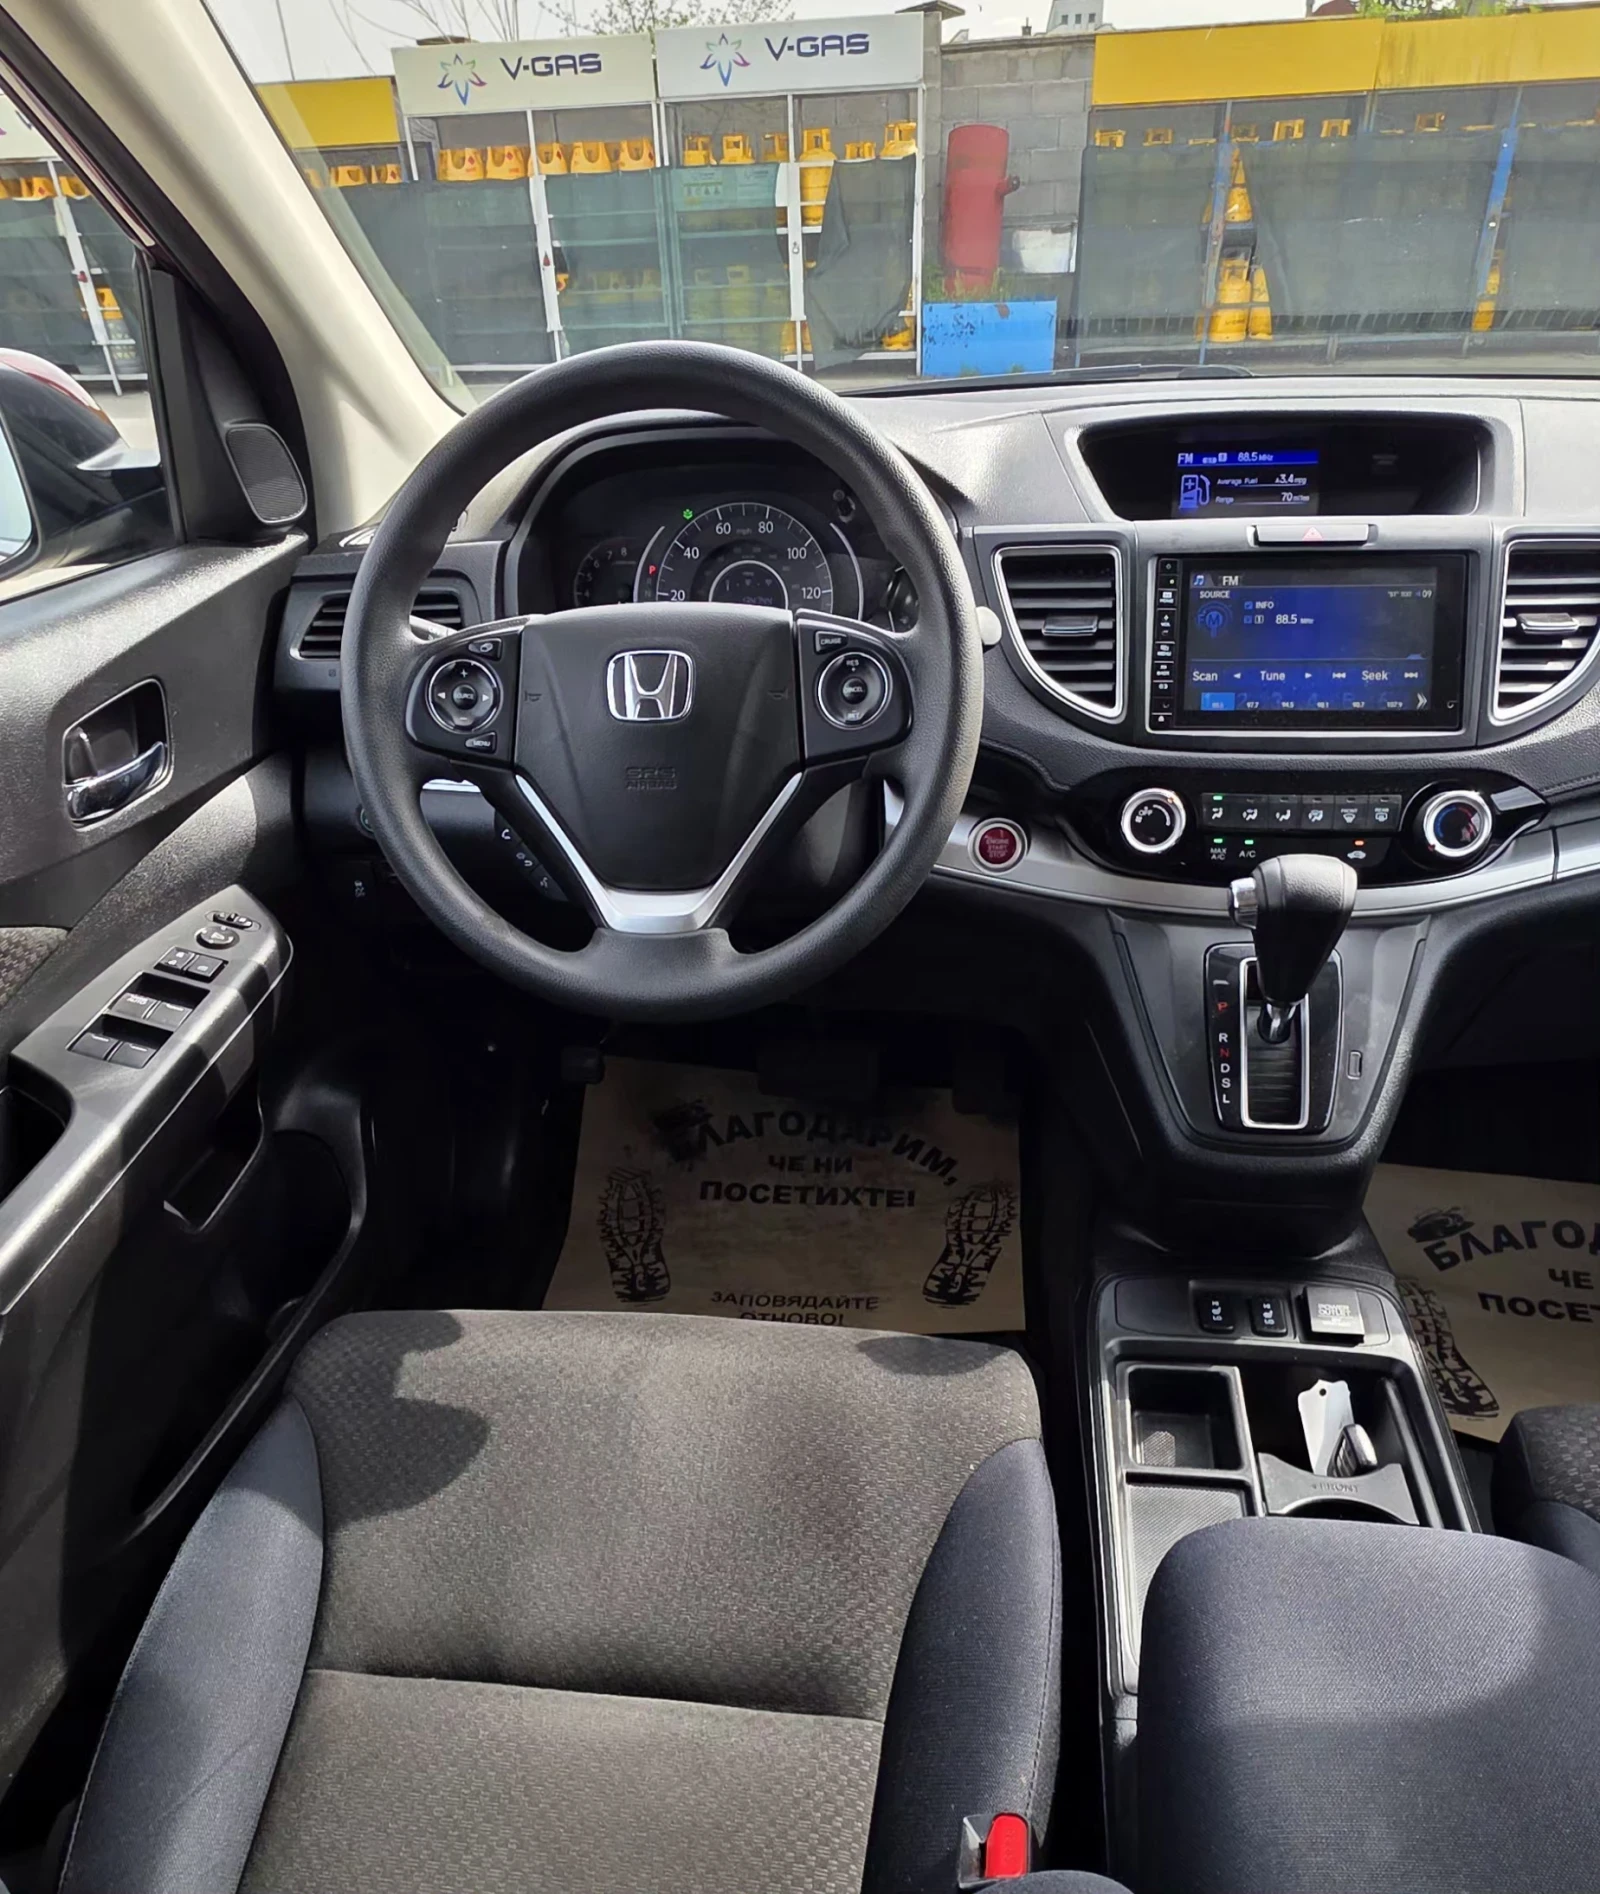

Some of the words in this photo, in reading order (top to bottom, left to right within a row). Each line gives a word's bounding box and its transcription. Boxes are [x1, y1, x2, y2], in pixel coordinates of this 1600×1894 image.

[765, 33, 870, 61] V-GAS
[500, 53, 602, 80] V-GAS
[1177, 453, 1194, 464] FM
[1237, 452, 1258, 462] 88.5
[715, 522, 732, 535] 60
[757, 520, 774, 534] 80
[683, 546, 700, 559] 40
[787, 546, 807, 559] 100
[648, 564, 657, 574] P
[1222, 575, 1239, 586] FM
[670, 589, 686, 601] 20
[801, 587, 822, 599] 120
[1199, 590, 1231, 599] SOURCE
[1255, 601, 1275, 610] INFO
[1275, 614, 1298, 625] 88.5
[820, 637, 842, 646] CRUISE
[845, 659, 860, 667] RES
[1192, 671, 1219, 681] Scan
[1260, 670, 1286, 681] Tune
[1361, 670, 1389, 681] Seek
[472, 740, 492, 748] MENU
[625, 766, 677, 779] SRS
[1210, 847, 1227, 855] MAX
[1239, 850, 1257, 859] A/C
[1211, 853, 1226, 861] A/C
[1217, 1001, 1229, 1012] P
[1218, 1032, 1229, 1043] R
[1219, 1048, 1230, 1058] N
[1220, 1063, 1231, 1074] D
[1221, 1077, 1232, 1089] S
[1222, 1093, 1231, 1104] L
[674, 1110, 959, 1187] ЛАГОДАРИМ,
[768, 1154, 805, 1173] ЧЕ
[813, 1155, 853, 1174] НИ
[699, 1181, 916, 1208] ПОСЕТИХТЕ!
[1547, 1267, 1595, 1290] ЧЕ
[710, 1291, 880, 1311] ЗАПОВЯДАЙТЕ
